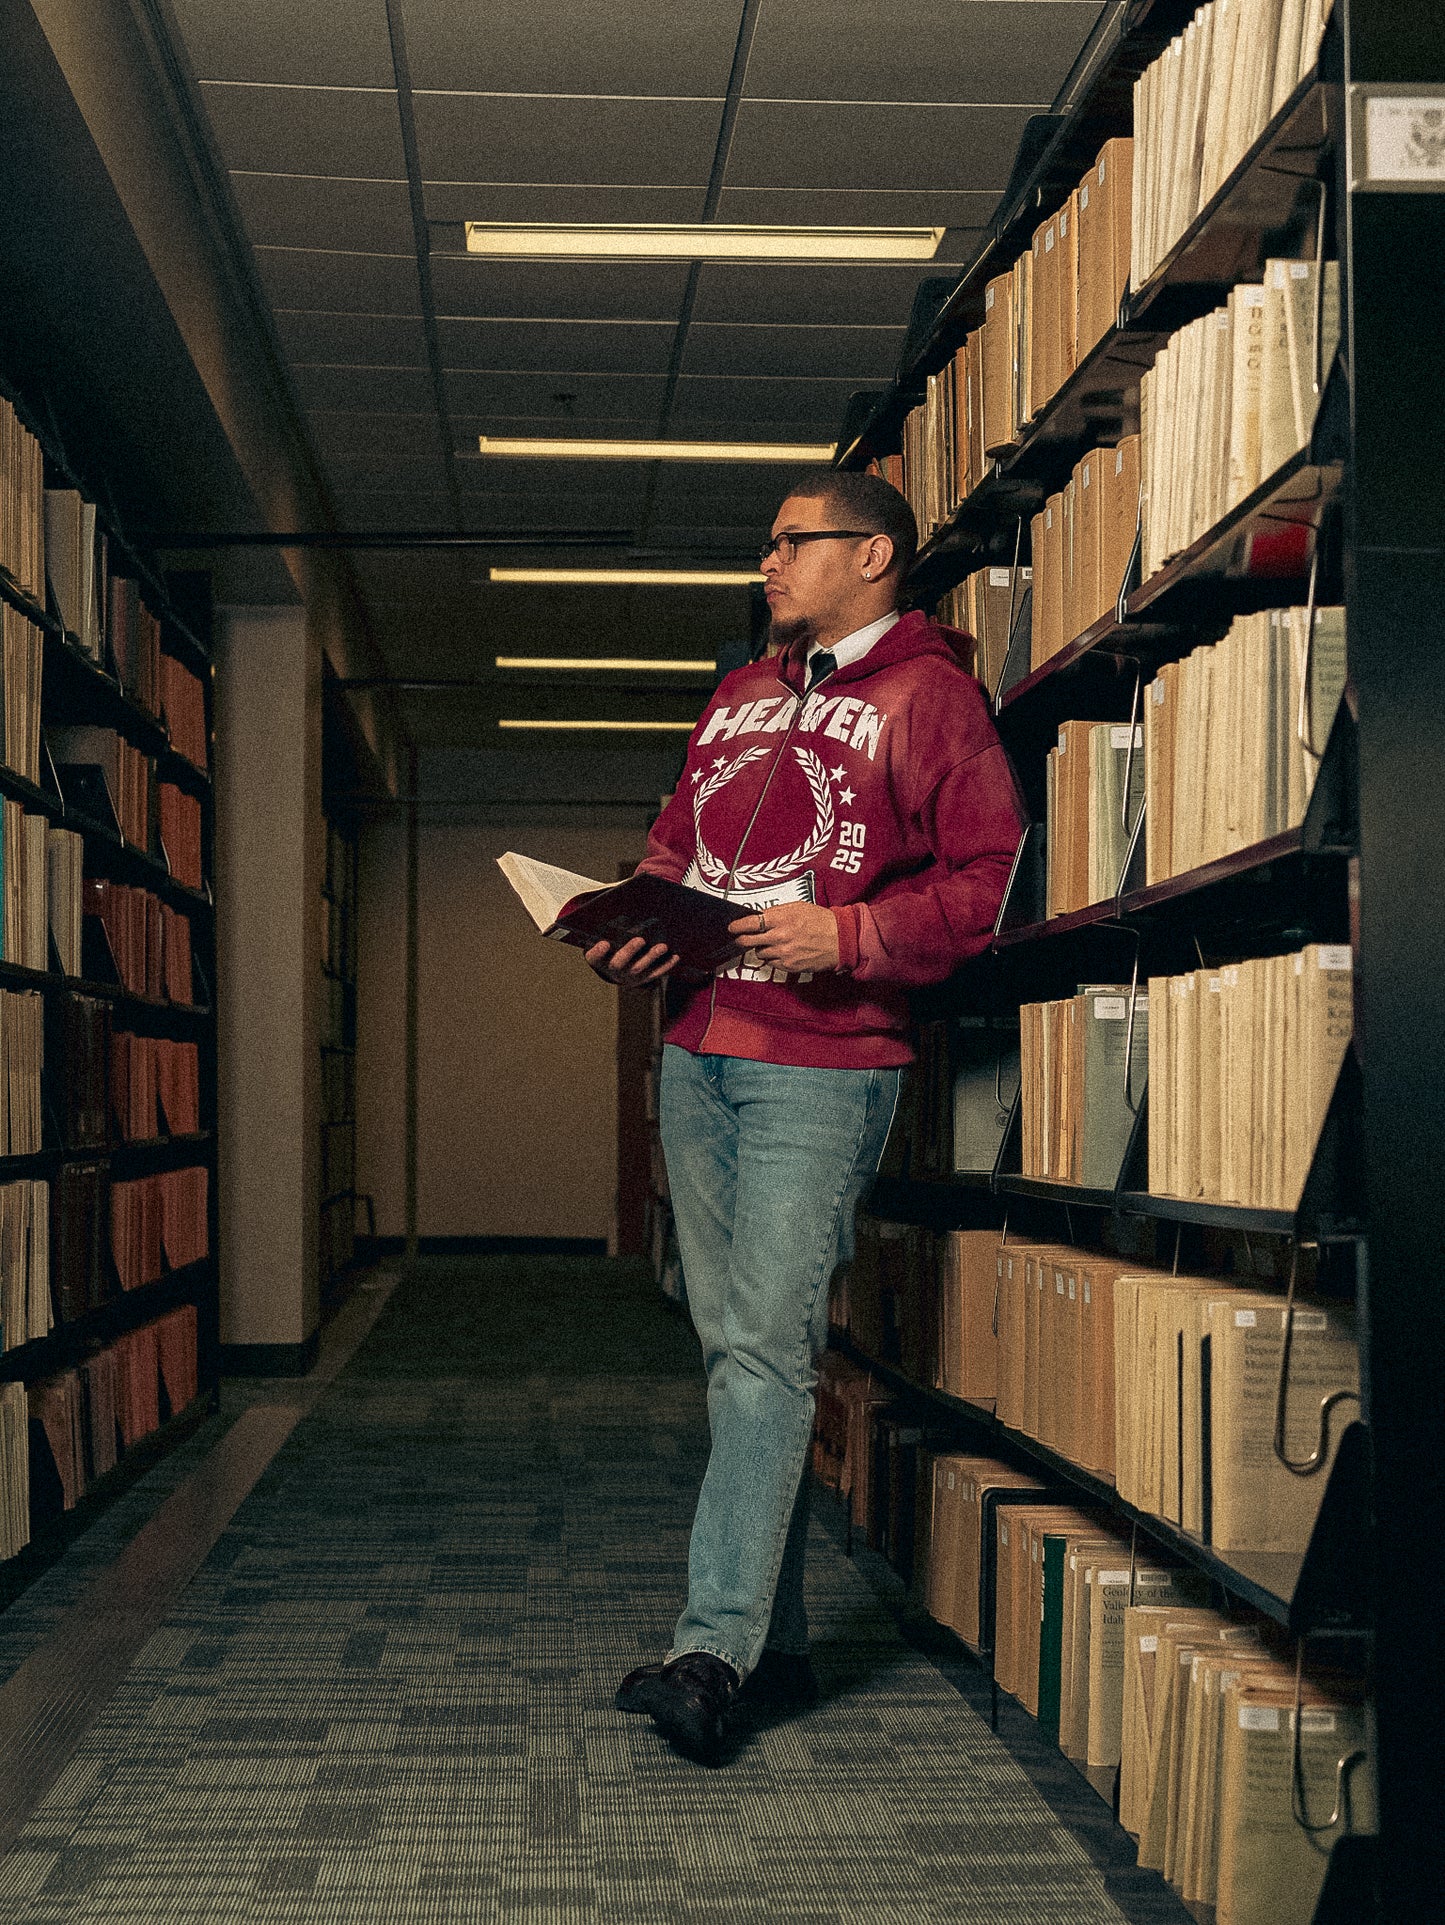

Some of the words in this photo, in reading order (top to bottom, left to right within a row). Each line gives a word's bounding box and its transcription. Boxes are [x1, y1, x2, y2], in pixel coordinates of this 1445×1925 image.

[696, 692, 888, 762] HEAVEN
[839, 820, 867, 849] 20
[829, 850, 864, 874] 25
